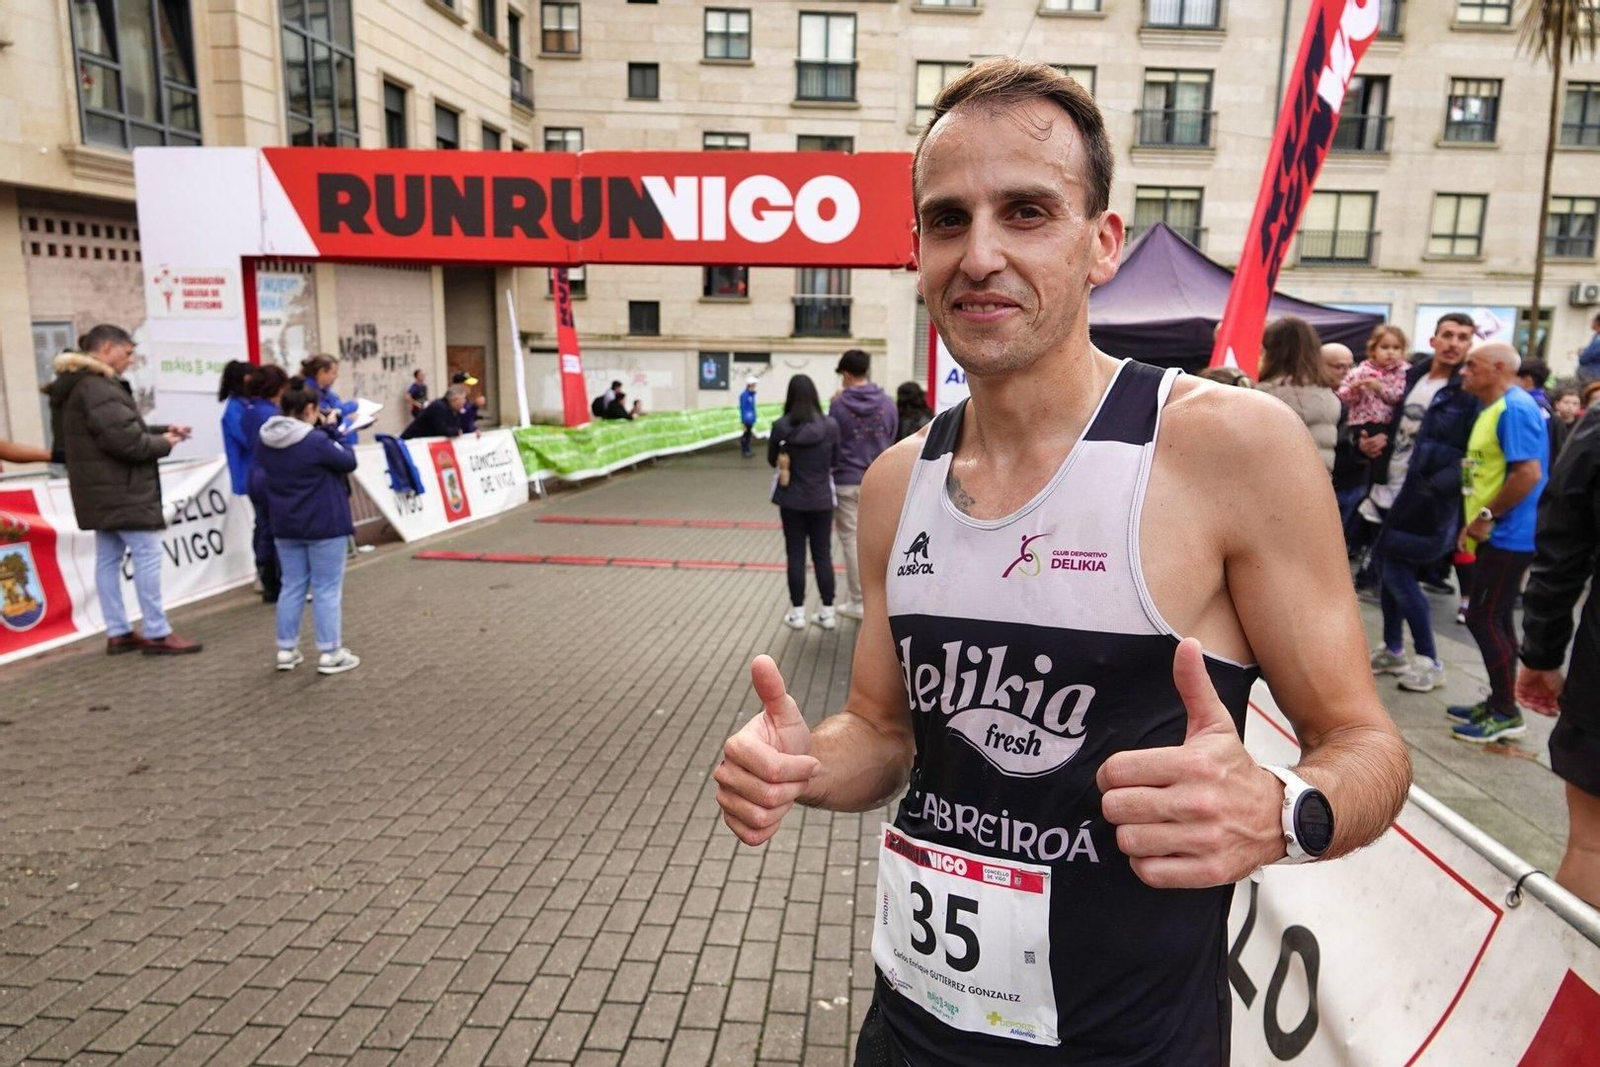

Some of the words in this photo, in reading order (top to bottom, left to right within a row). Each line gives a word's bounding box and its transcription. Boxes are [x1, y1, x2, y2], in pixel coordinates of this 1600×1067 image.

[161, 529, 224, 567] VIGO
[1051, 558, 1106, 572] DELIKIA
[1070, 550, 1108, 558] DEPORTIVO
[900, 636, 1097, 736] delikia
[984, 723, 1042, 757] fresh
[910, 880, 981, 972] 35
[894, 948, 909, 963] Carlos
[909, 957, 929, 976] Enrique
[929, 970, 966, 993] GUTIERREZ
[968, 985, 1021, 1003] GONZALEZ
